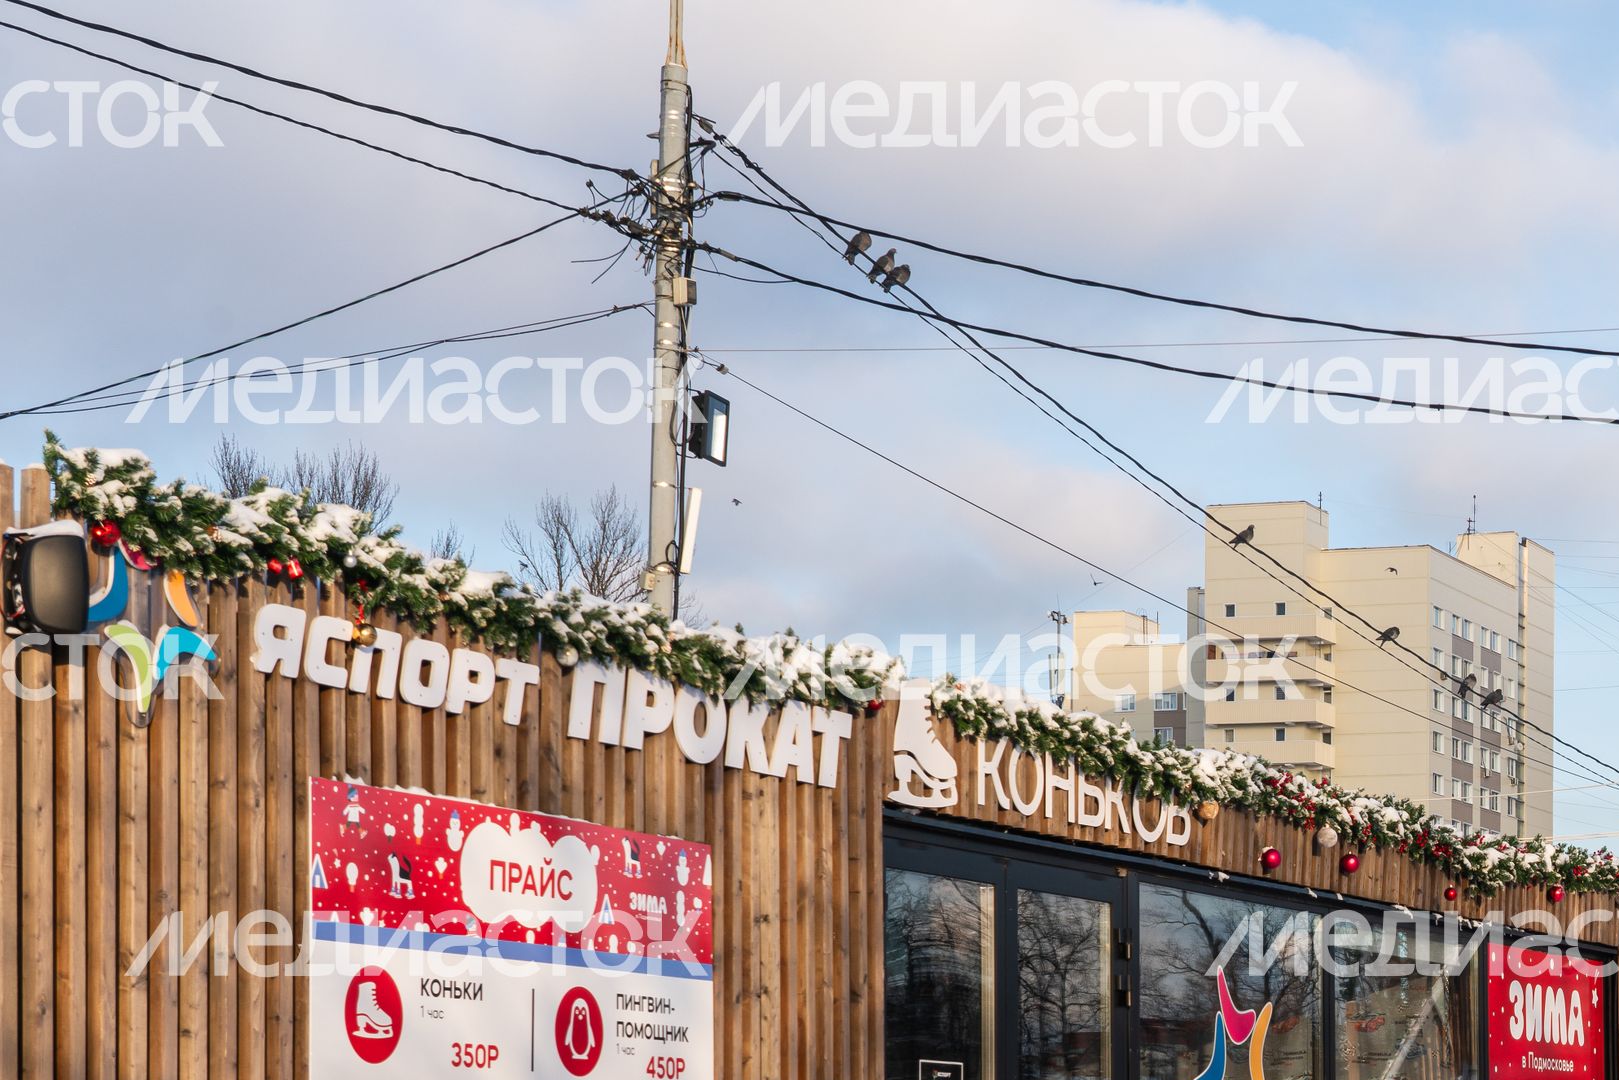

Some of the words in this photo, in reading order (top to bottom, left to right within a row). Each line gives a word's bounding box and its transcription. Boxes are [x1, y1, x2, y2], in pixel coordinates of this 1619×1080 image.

[250, 603, 540, 726] ЯСПОРТ
[567, 660, 852, 788] ПРОКАТ
[977, 736, 1191, 846] КОНЬКОВ
[490, 857, 573, 900] ПРАЙС
[629, 891, 667, 914] ЗИМА
[421, 978, 484, 1001] КОНЬКИ
[427, 1008, 445, 1019] час
[616, 993, 675, 1015] ПИНГВИН-
[1509, 980, 1584, 1046] ЗИМА
[616, 1021, 689, 1044] ПОМОЩНИК
[1528, 1052, 1574, 1072] Подмосковье
